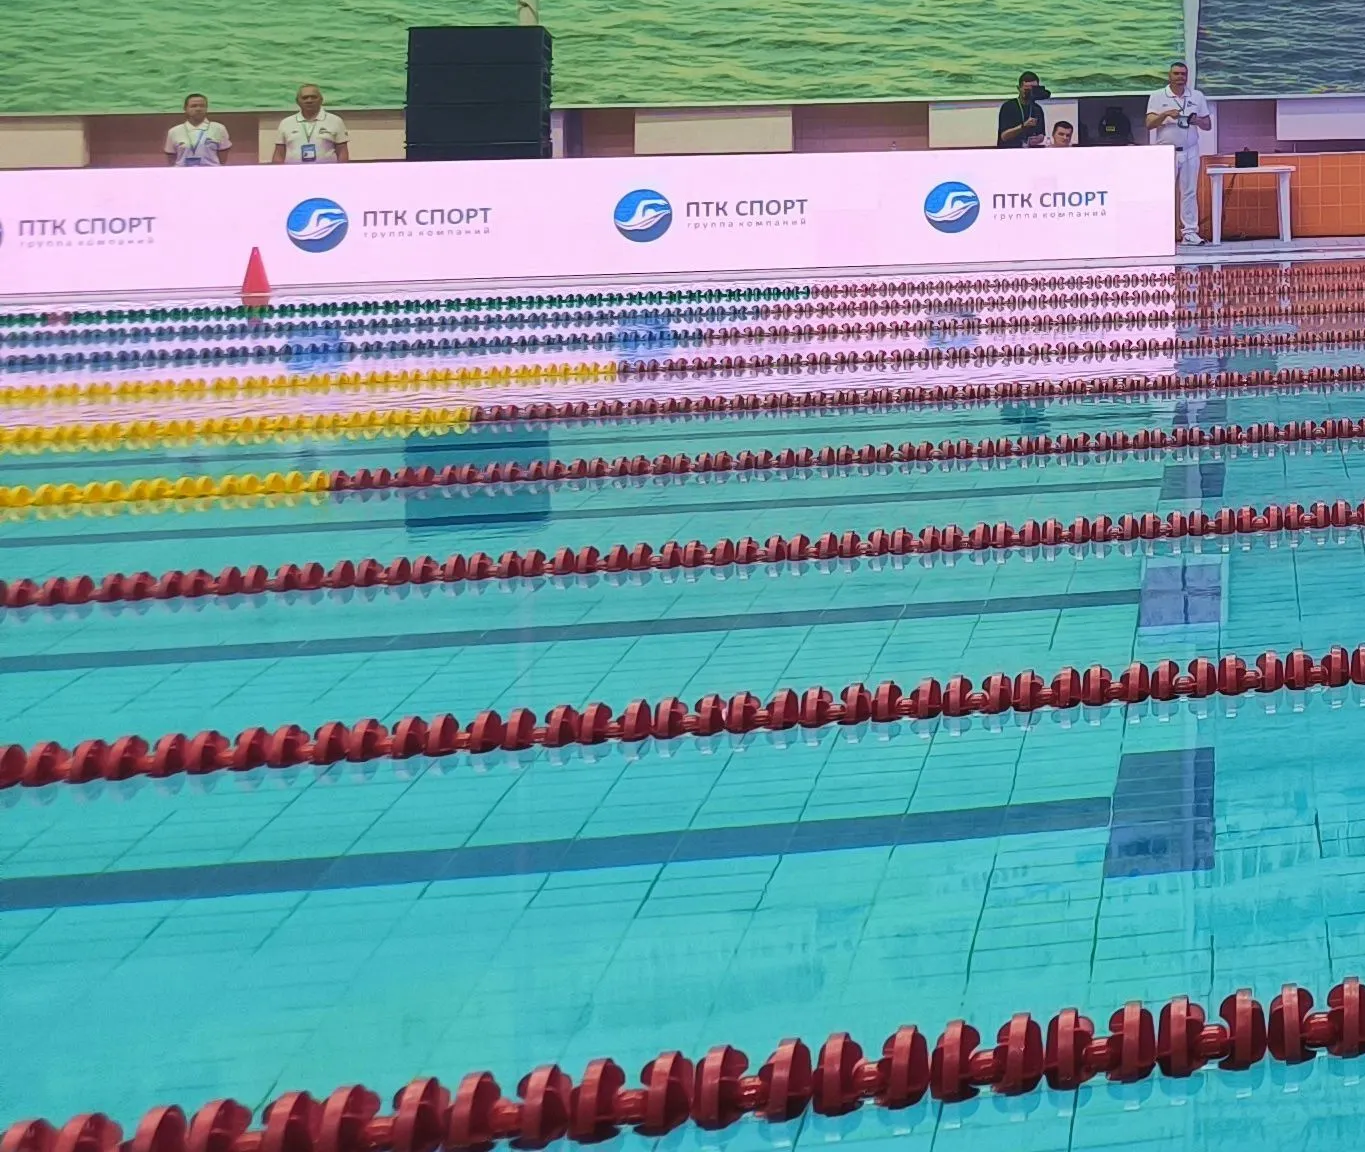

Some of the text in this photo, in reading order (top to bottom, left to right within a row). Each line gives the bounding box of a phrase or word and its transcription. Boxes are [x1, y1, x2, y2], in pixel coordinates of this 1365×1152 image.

[686, 198, 808, 218] ПТК СПОРТ
[993, 190, 1108, 209] ПТК СПОРТ
[18, 216, 157, 237] ПТК СПОРТ
[362, 207, 492, 227] ПТК СПОРТ
